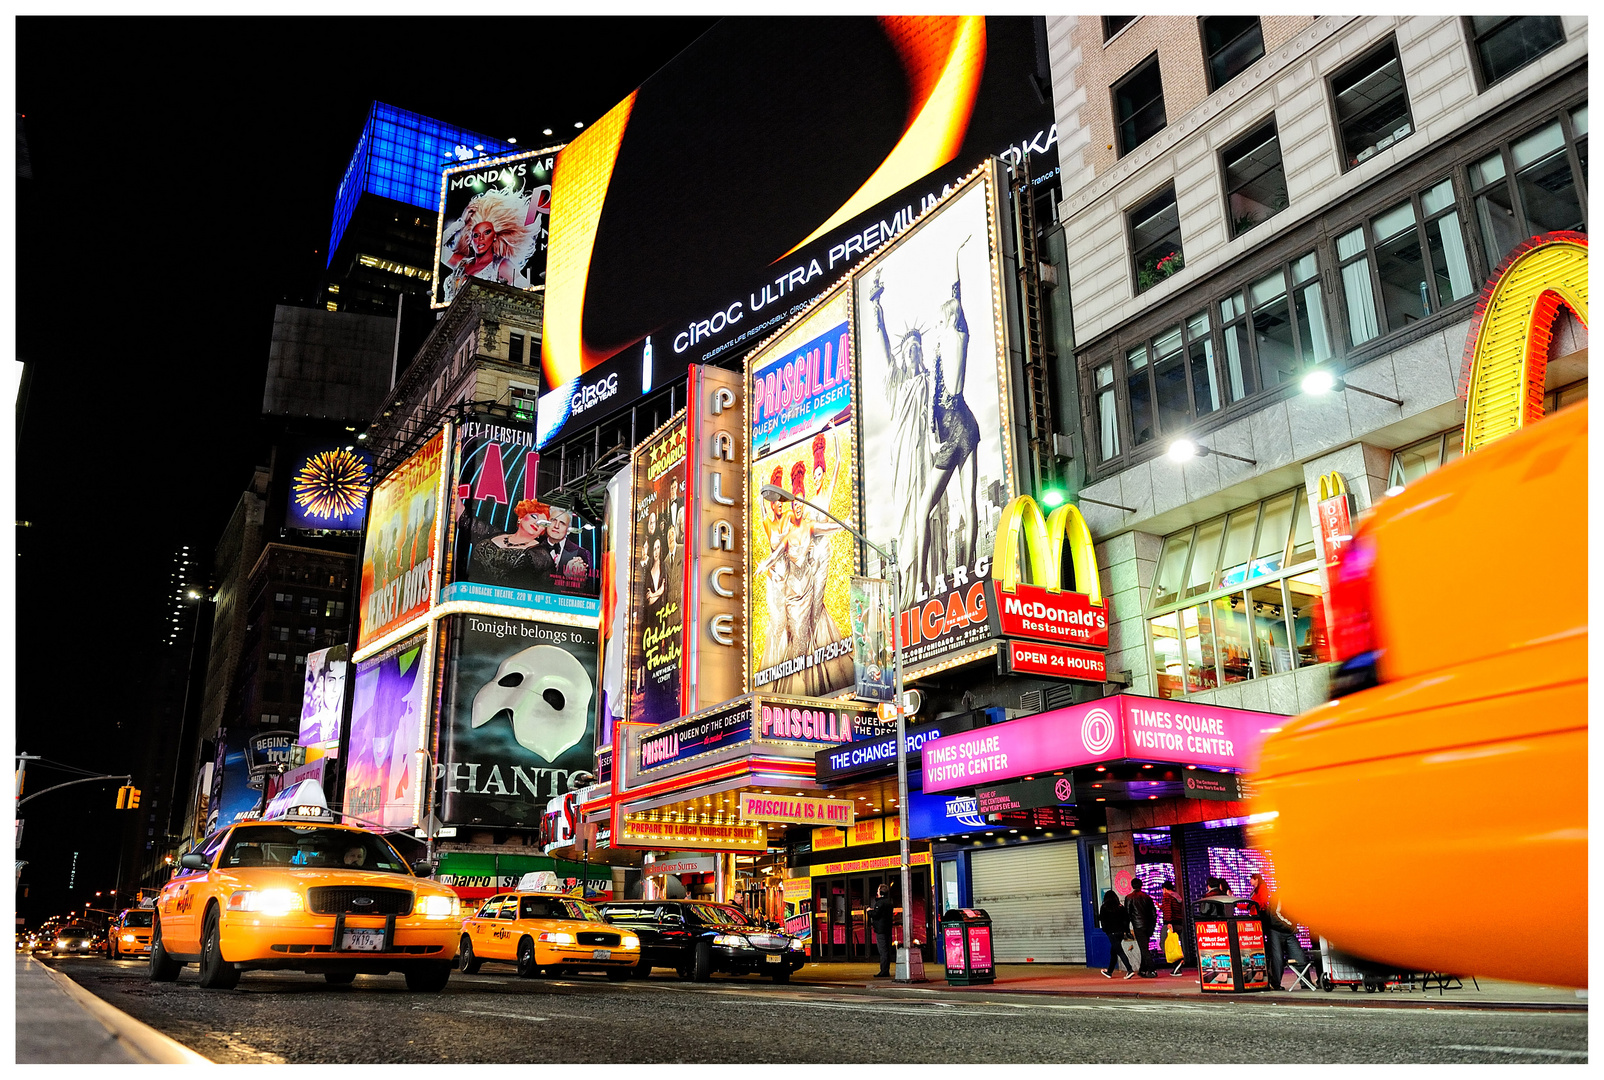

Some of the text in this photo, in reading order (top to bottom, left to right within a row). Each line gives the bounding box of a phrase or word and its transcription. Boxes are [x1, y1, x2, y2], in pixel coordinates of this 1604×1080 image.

[450, 164, 527, 191] MONDAYS
[751, 258, 823, 312] ULTRA
[702, 340, 734, 361] CELEBRATE
[734, 333, 746, 345] LIFE
[753, 333, 850, 424] PRISCILLA
[572, 406, 585, 416] THE
[584, 397, 599, 411] NEW
[753, 383, 849, 438] QUEEN OF THE DESERT
[484, 423, 533, 447] FIERSTEIN
[637, 491, 657, 511] NATHAN
[637, 505, 649, 522] LANE
[710, 386, 737, 646] PALACE
[364, 557, 432, 636] JERSEY BOYS
[469, 585, 493, 597] LONGACRE
[656, 602, 678, 624] The
[1005, 598, 1106, 629] McDonald's
[469, 618, 518, 638] Tonight
[520, 623, 567, 644] belongs
[1022, 619, 1090, 638] Restaurant
[754, 655, 806, 688] TICKETMASTER.COM
[1016, 651, 1104, 672] OPEN 24 HOURS
[762, 705, 885, 743] PRISCILLA QUEEN
[854, 726, 872, 736] THE
[1131, 708, 1224, 736] TIMES SQUARE
[257, 737, 289, 751] BEGINS
[642, 709, 750, 767] PRISCILLA QUEEN OF THE DESERT
[927, 735, 1000, 765] TIMES SQUARE
[1132, 730, 1235, 757] VISITOR CENTER
[830, 752, 850, 770] THE
[852, 740, 896, 764] CHANGE
[927, 753, 1008, 783] VISITOR CENTER
[804, 803, 814, 818] IS
[817, 804, 824, 819] A
[946, 800, 976, 815] MONEY
[664, 825, 673, 834] TO
[675, 825, 697, 836] LAUGH
[699, 827, 732, 837] YOURSELF
[661, 863, 676, 872] GUEST
[678, 861, 697, 871] SUITES
[351, 934, 370, 946] 9K19
